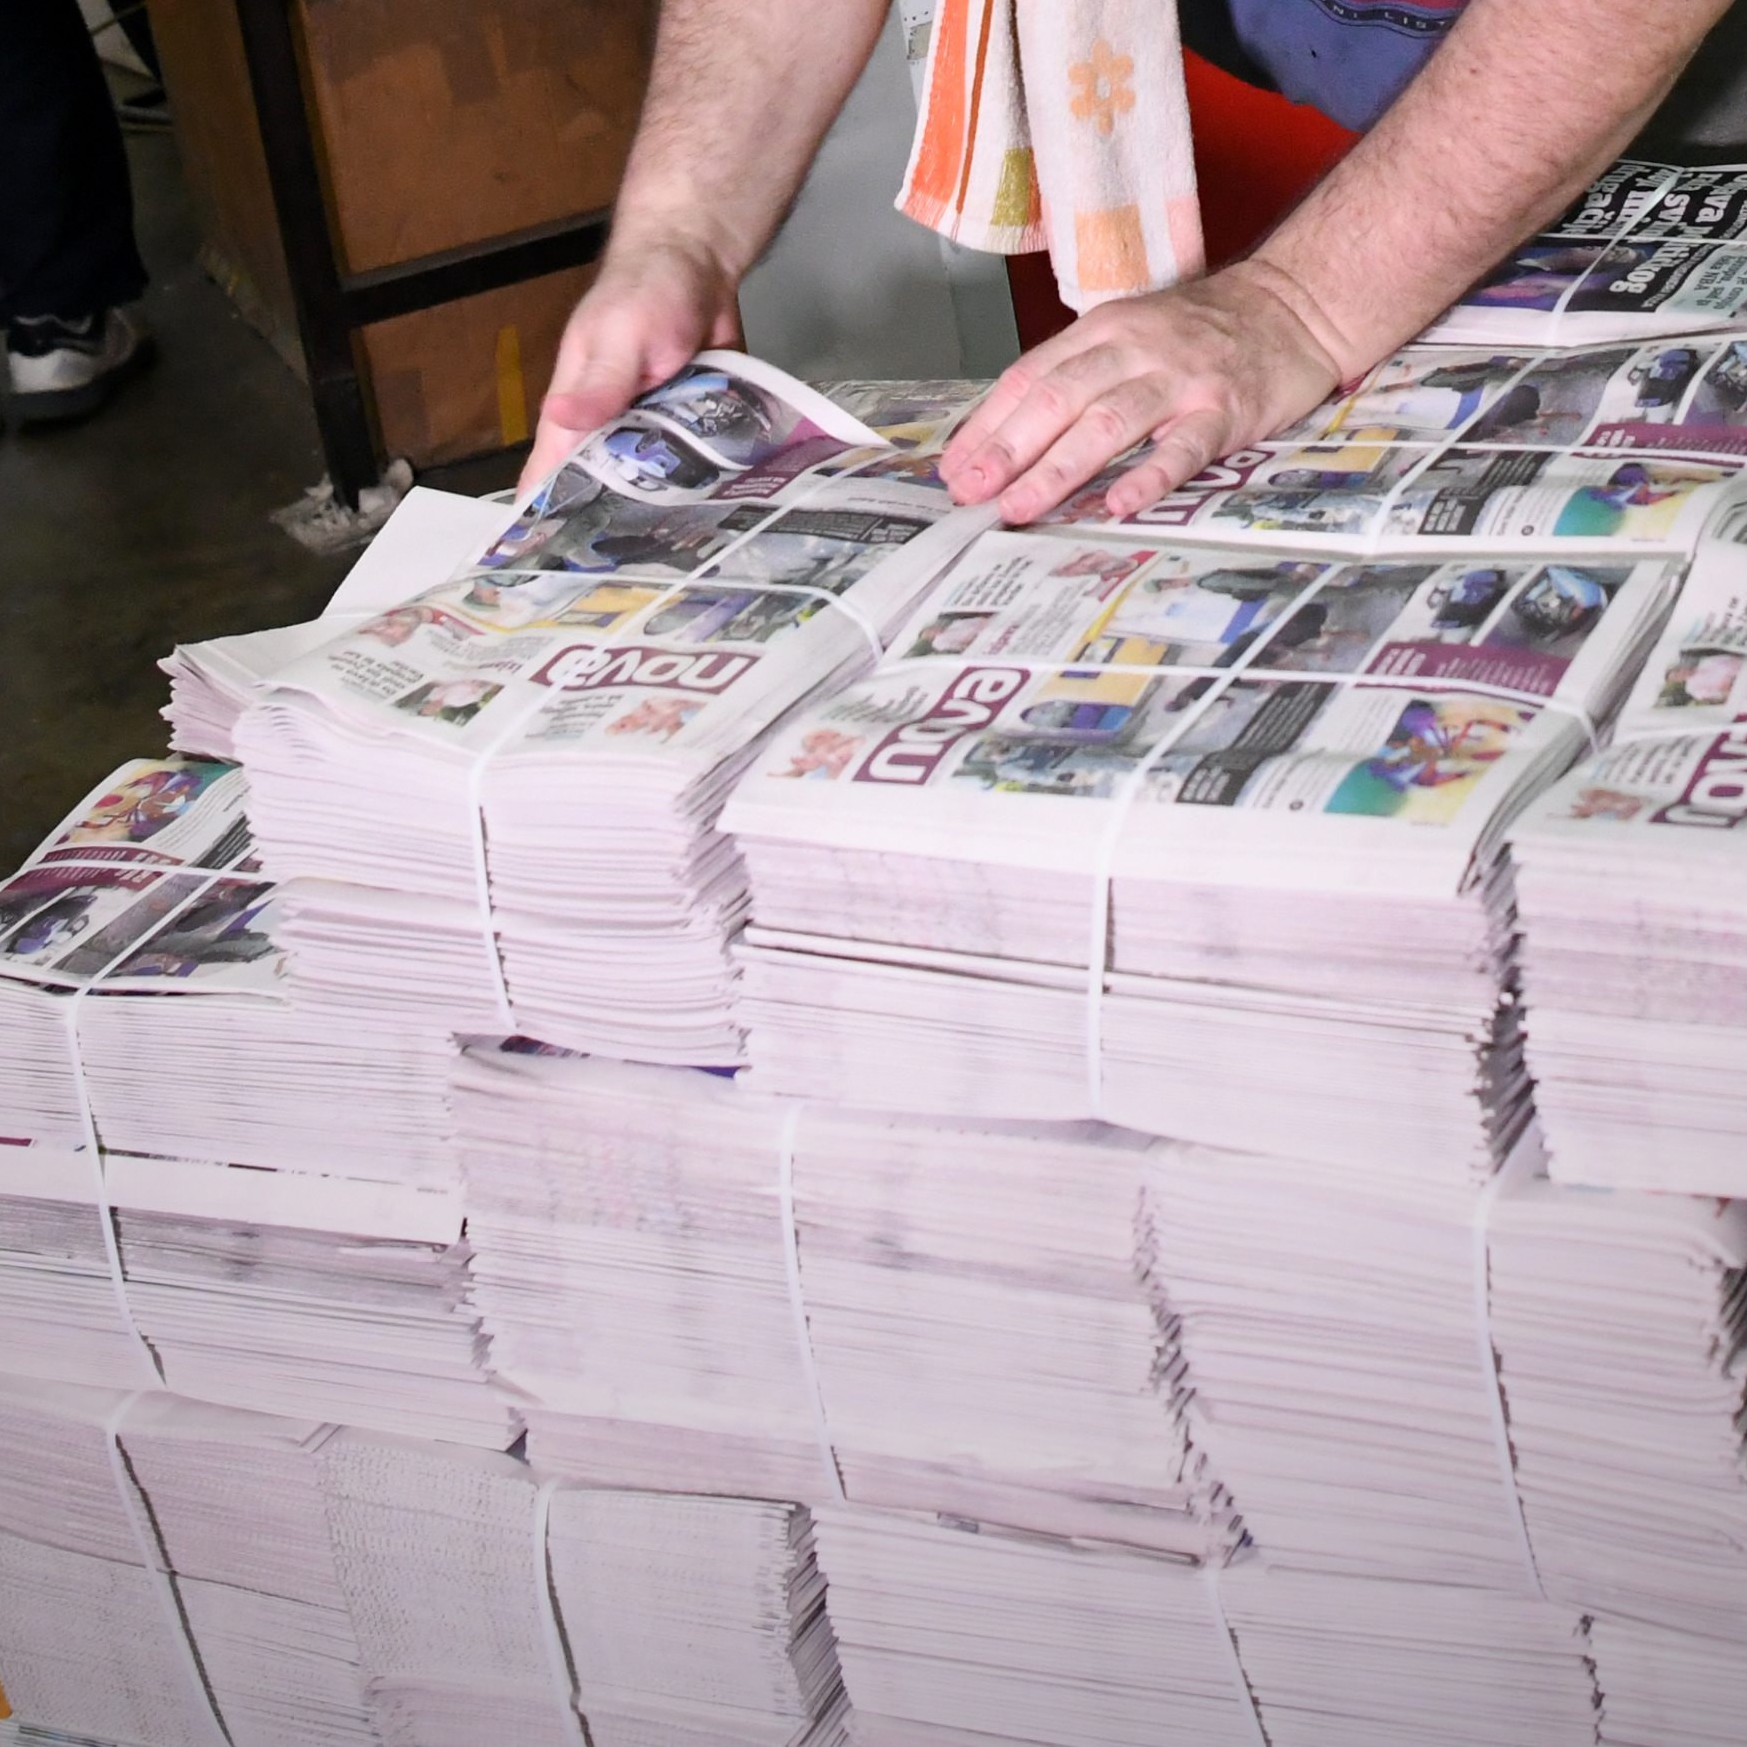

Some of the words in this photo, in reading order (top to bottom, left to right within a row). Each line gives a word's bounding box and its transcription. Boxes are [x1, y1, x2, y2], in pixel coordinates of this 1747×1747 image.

[1694, 272, 1720, 291] NBA
[557, 648, 751, 691] nova
[868, 667, 1022, 781] nova
